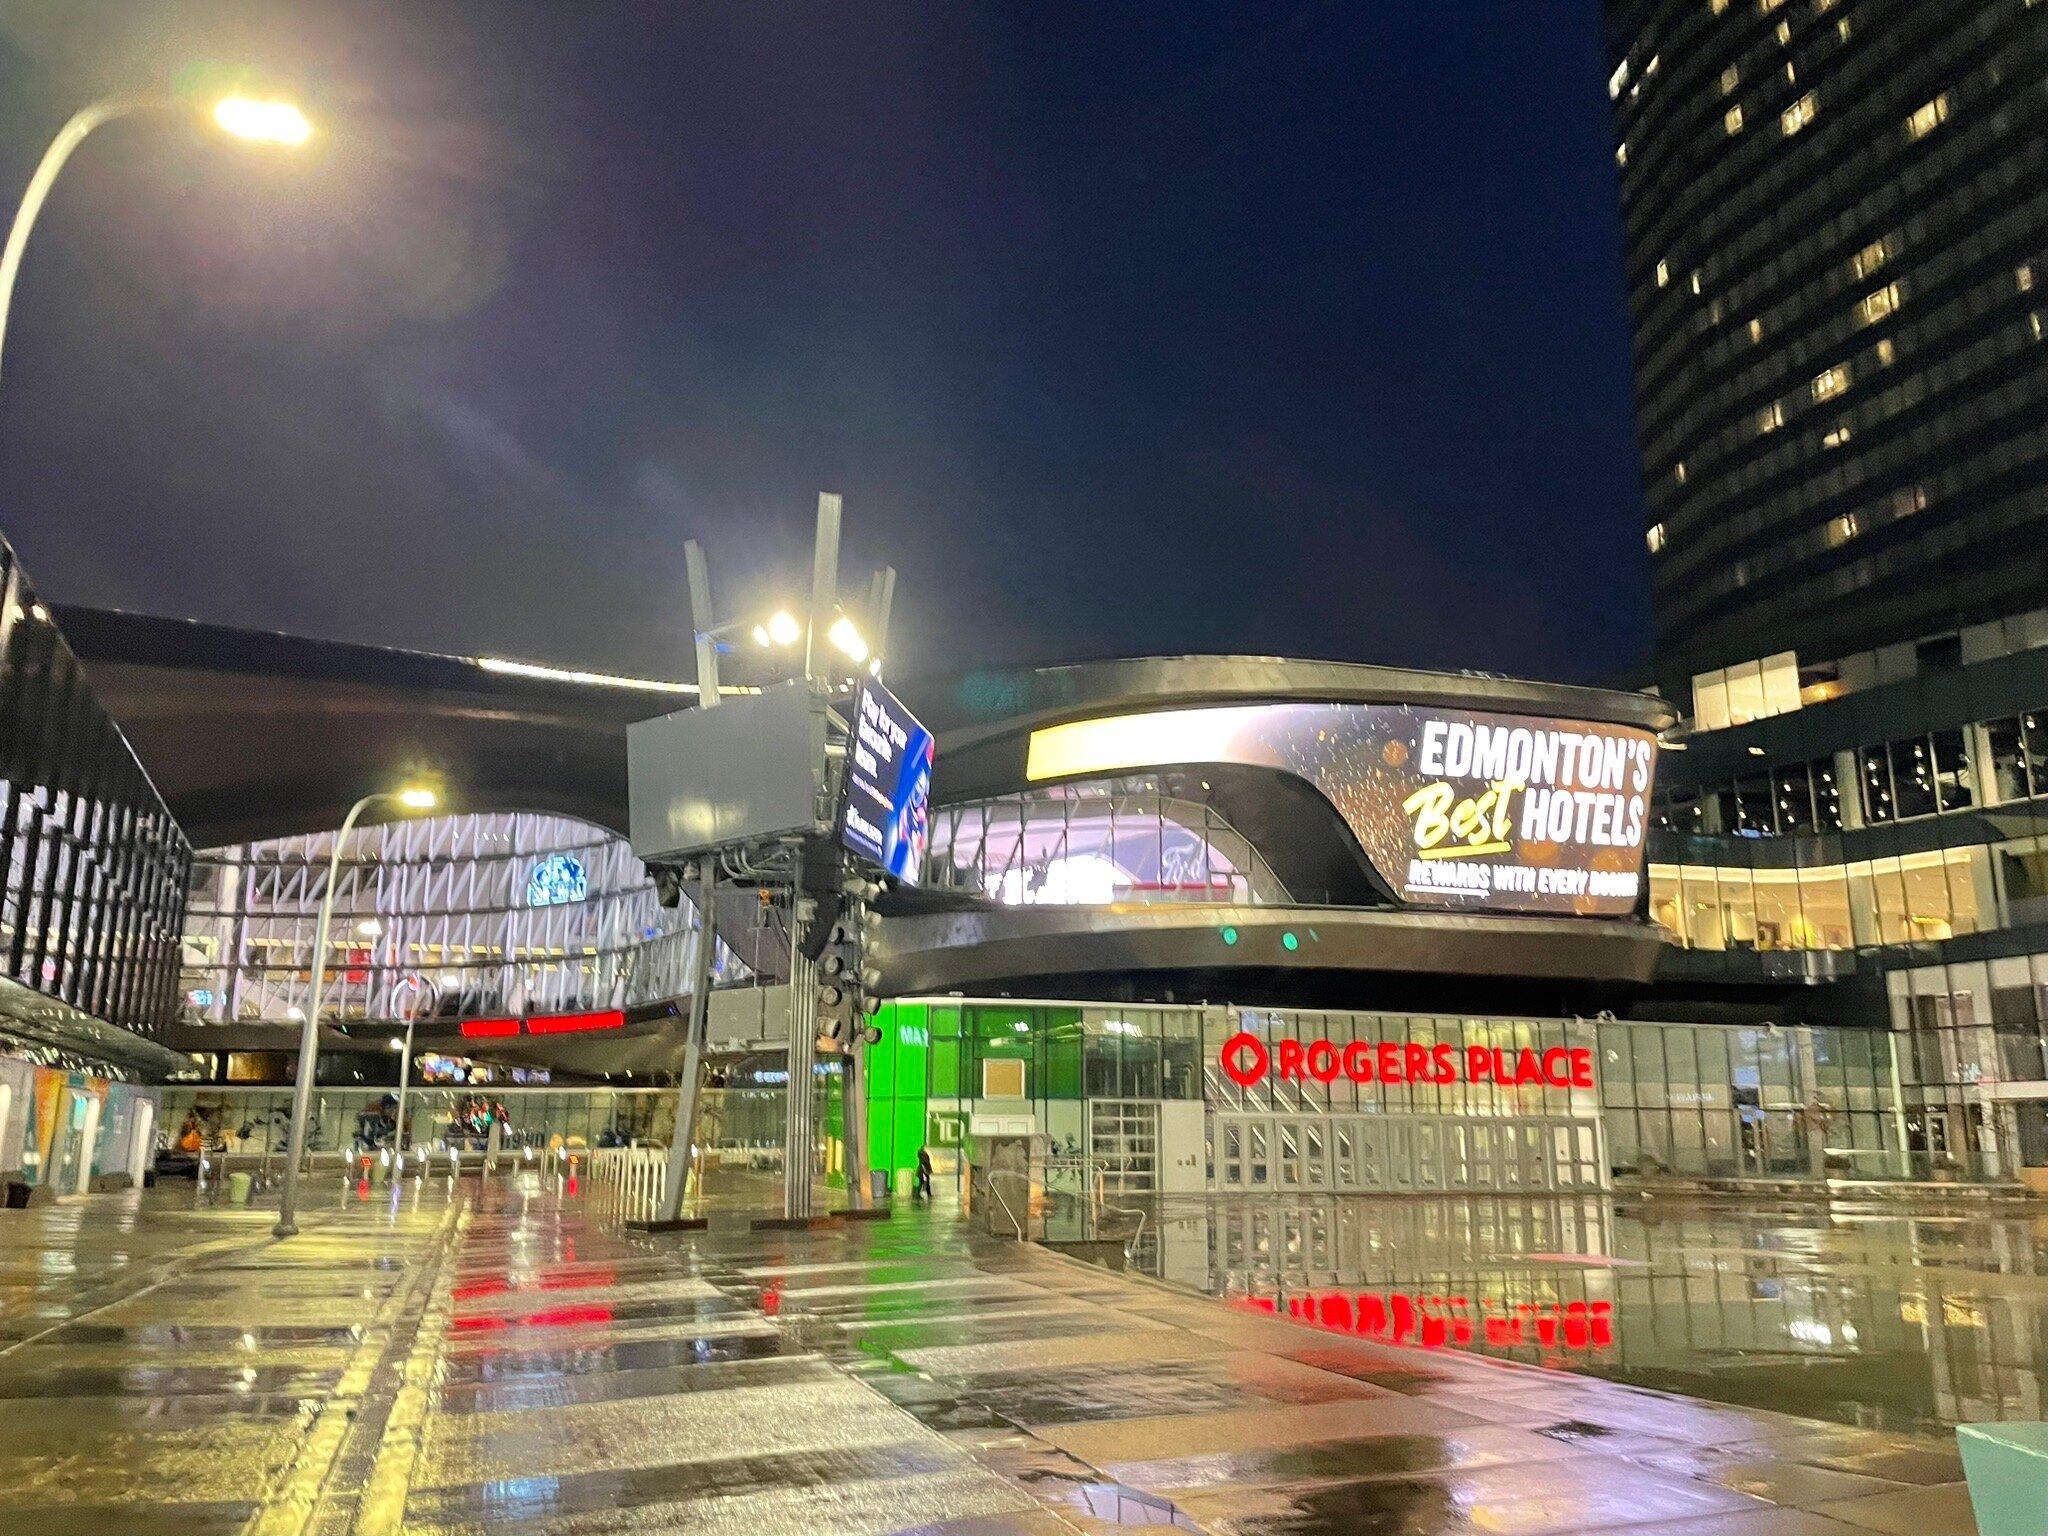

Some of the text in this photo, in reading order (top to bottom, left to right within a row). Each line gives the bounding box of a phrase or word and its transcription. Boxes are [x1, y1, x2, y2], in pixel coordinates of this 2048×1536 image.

[1419, 720, 1651, 792] EDMONTON'S
[1402, 776, 1645, 848] Best HOTELS
[1408, 859, 1491, 889] REWARDS
[1493, 865, 1538, 893] WITH
[1538, 867, 1590, 895] EVERY
[1279, 1039, 1593, 1088] ROGERS PLACE
